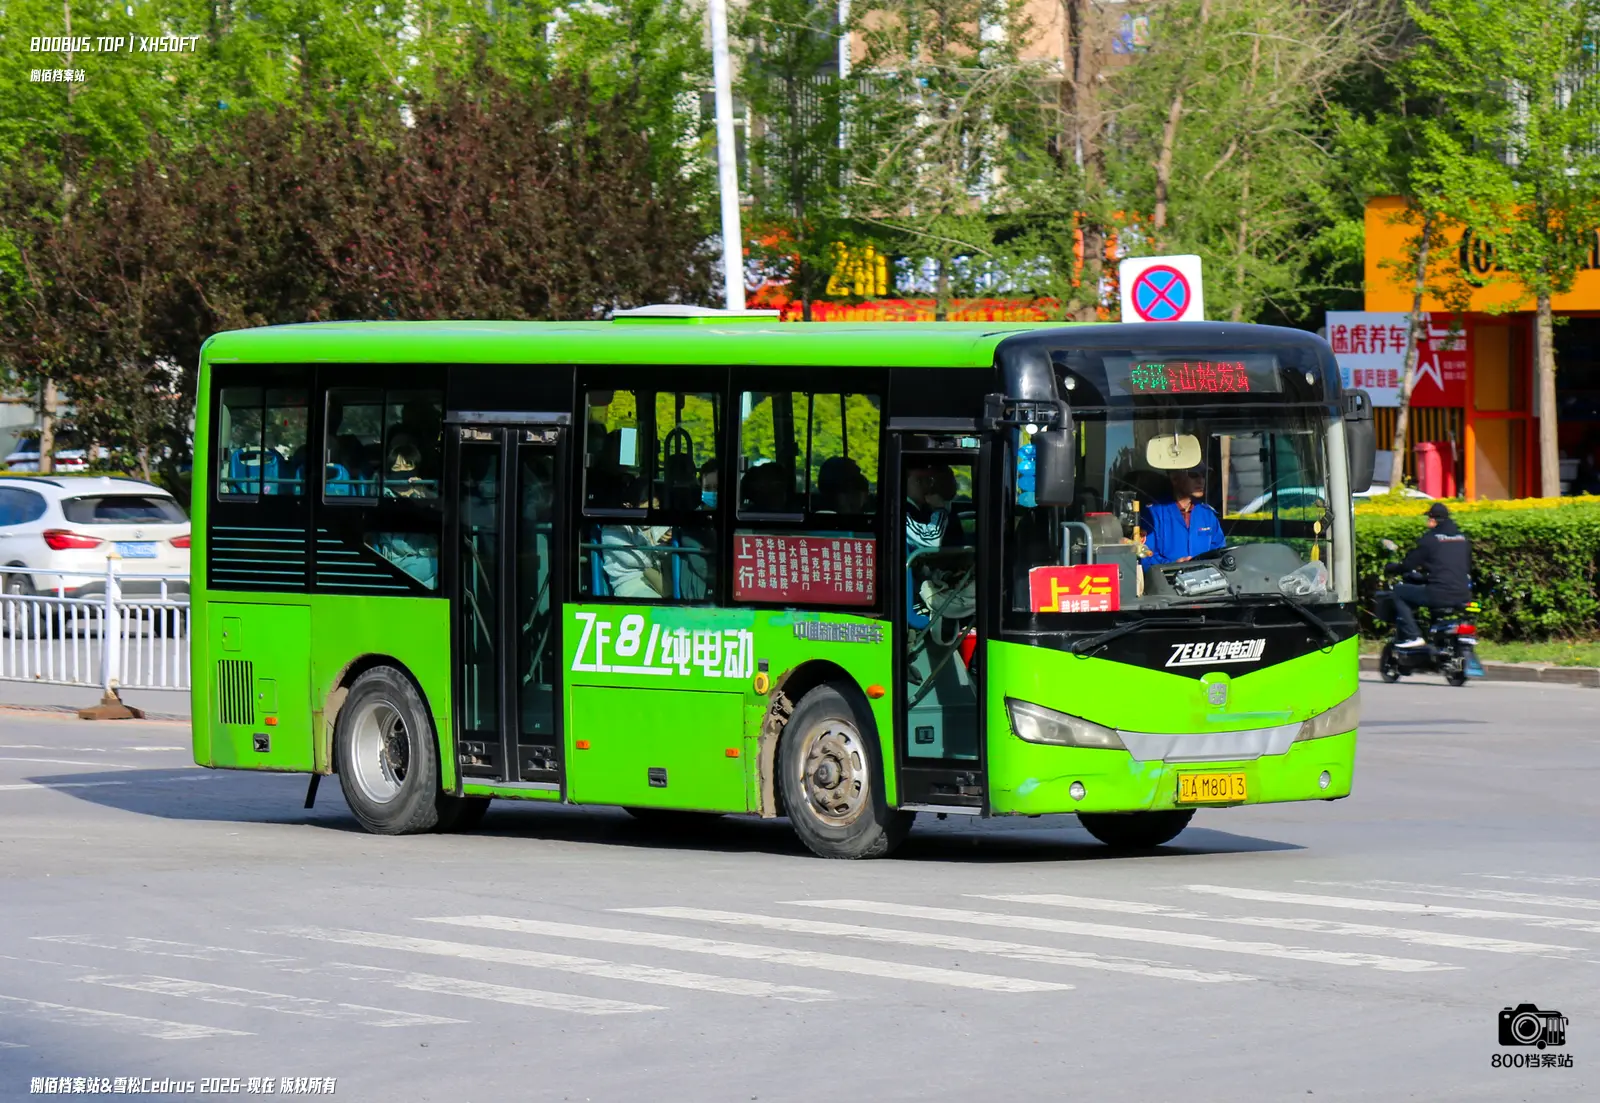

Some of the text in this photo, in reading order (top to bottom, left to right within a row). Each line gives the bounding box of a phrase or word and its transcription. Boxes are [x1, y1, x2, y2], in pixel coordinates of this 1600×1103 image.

[1331, 324, 1406, 354] 途虎养车
[738, 537, 755, 589] 上行
[789, 545, 799, 584] 大润发
[810, 547, 821, 583] 一克拉
